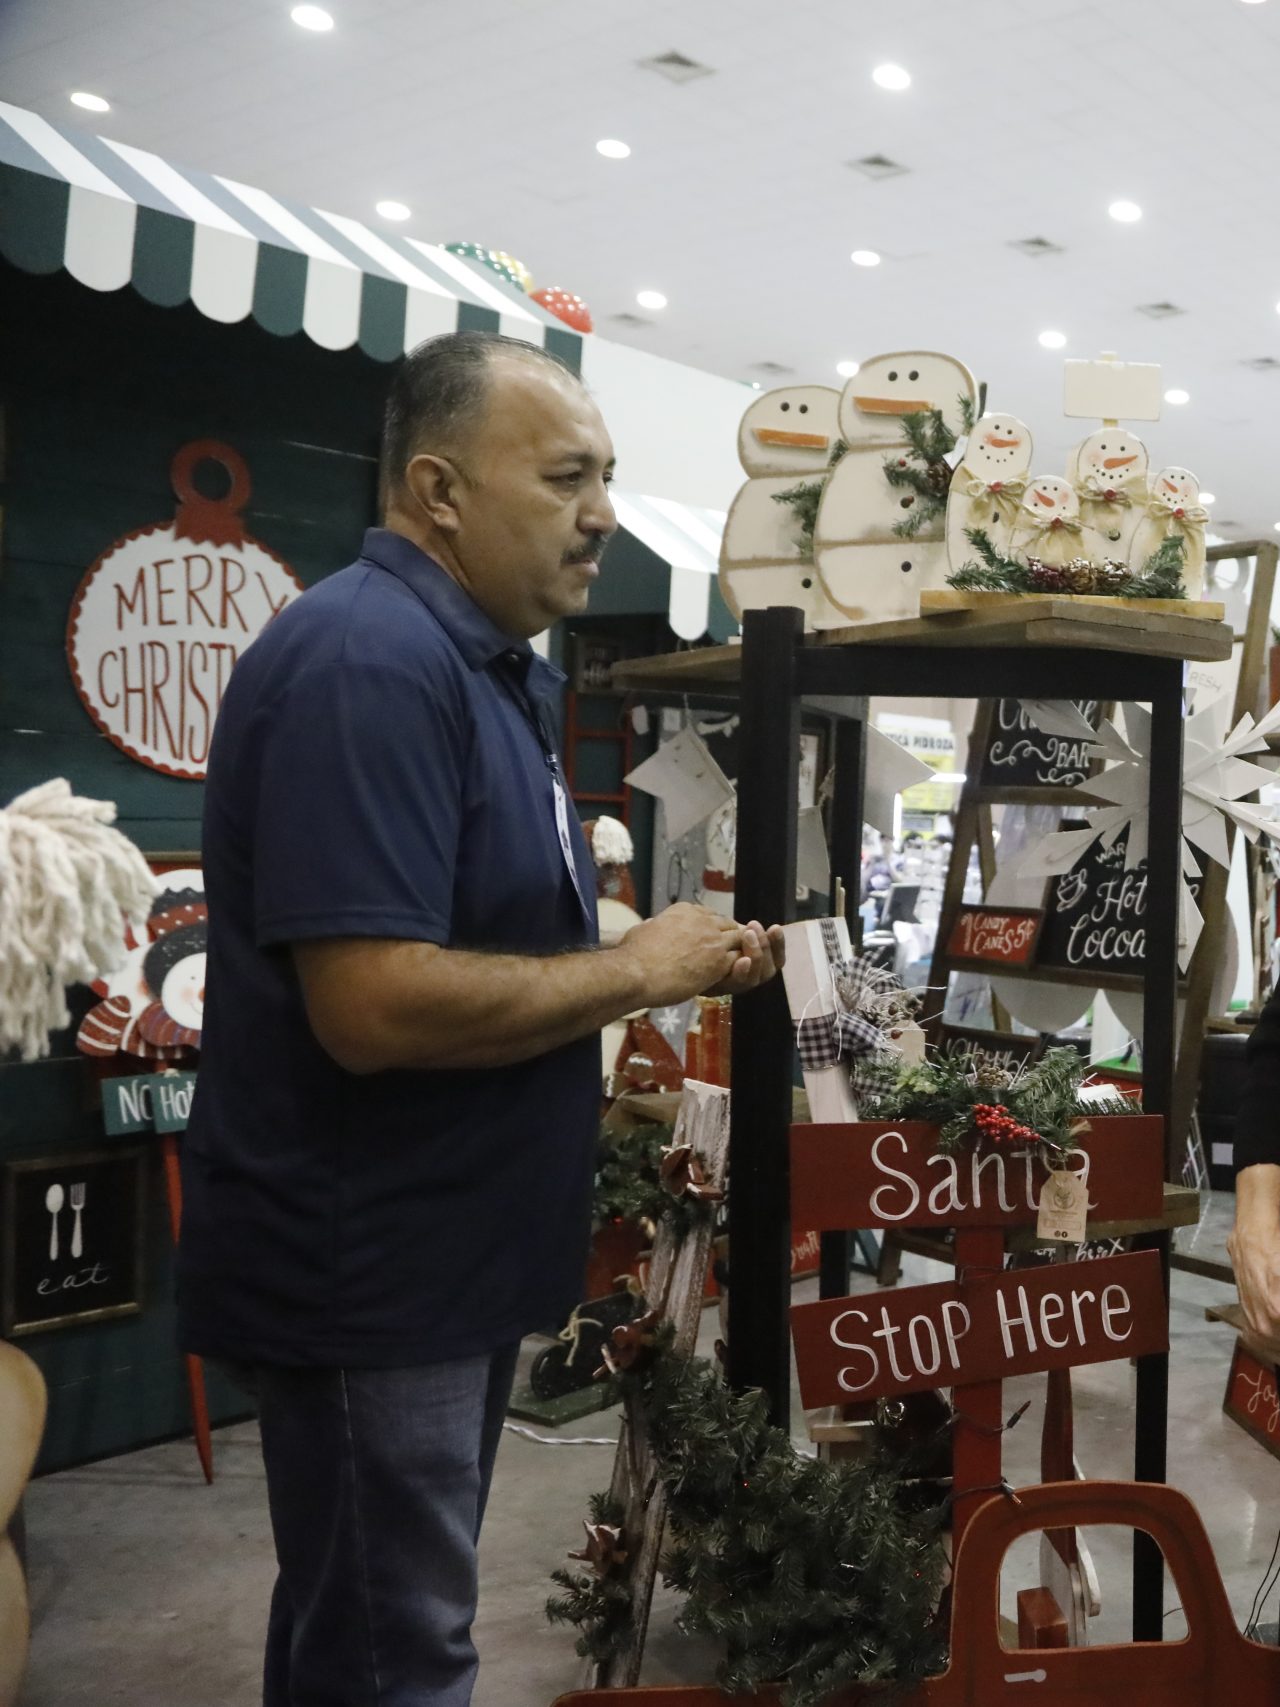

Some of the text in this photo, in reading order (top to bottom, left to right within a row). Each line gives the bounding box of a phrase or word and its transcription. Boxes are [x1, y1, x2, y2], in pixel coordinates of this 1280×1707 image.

[114, 554, 288, 632] MERRY
[98, 640, 238, 763] CHRIST
[1091, 874, 1147, 922] Hot
[1067, 913, 1146, 964] Cocoa
[869, 1131, 1098, 1221] Santa
[36, 1262, 110, 1295] eat
[996, 1284, 1133, 1359] Here
